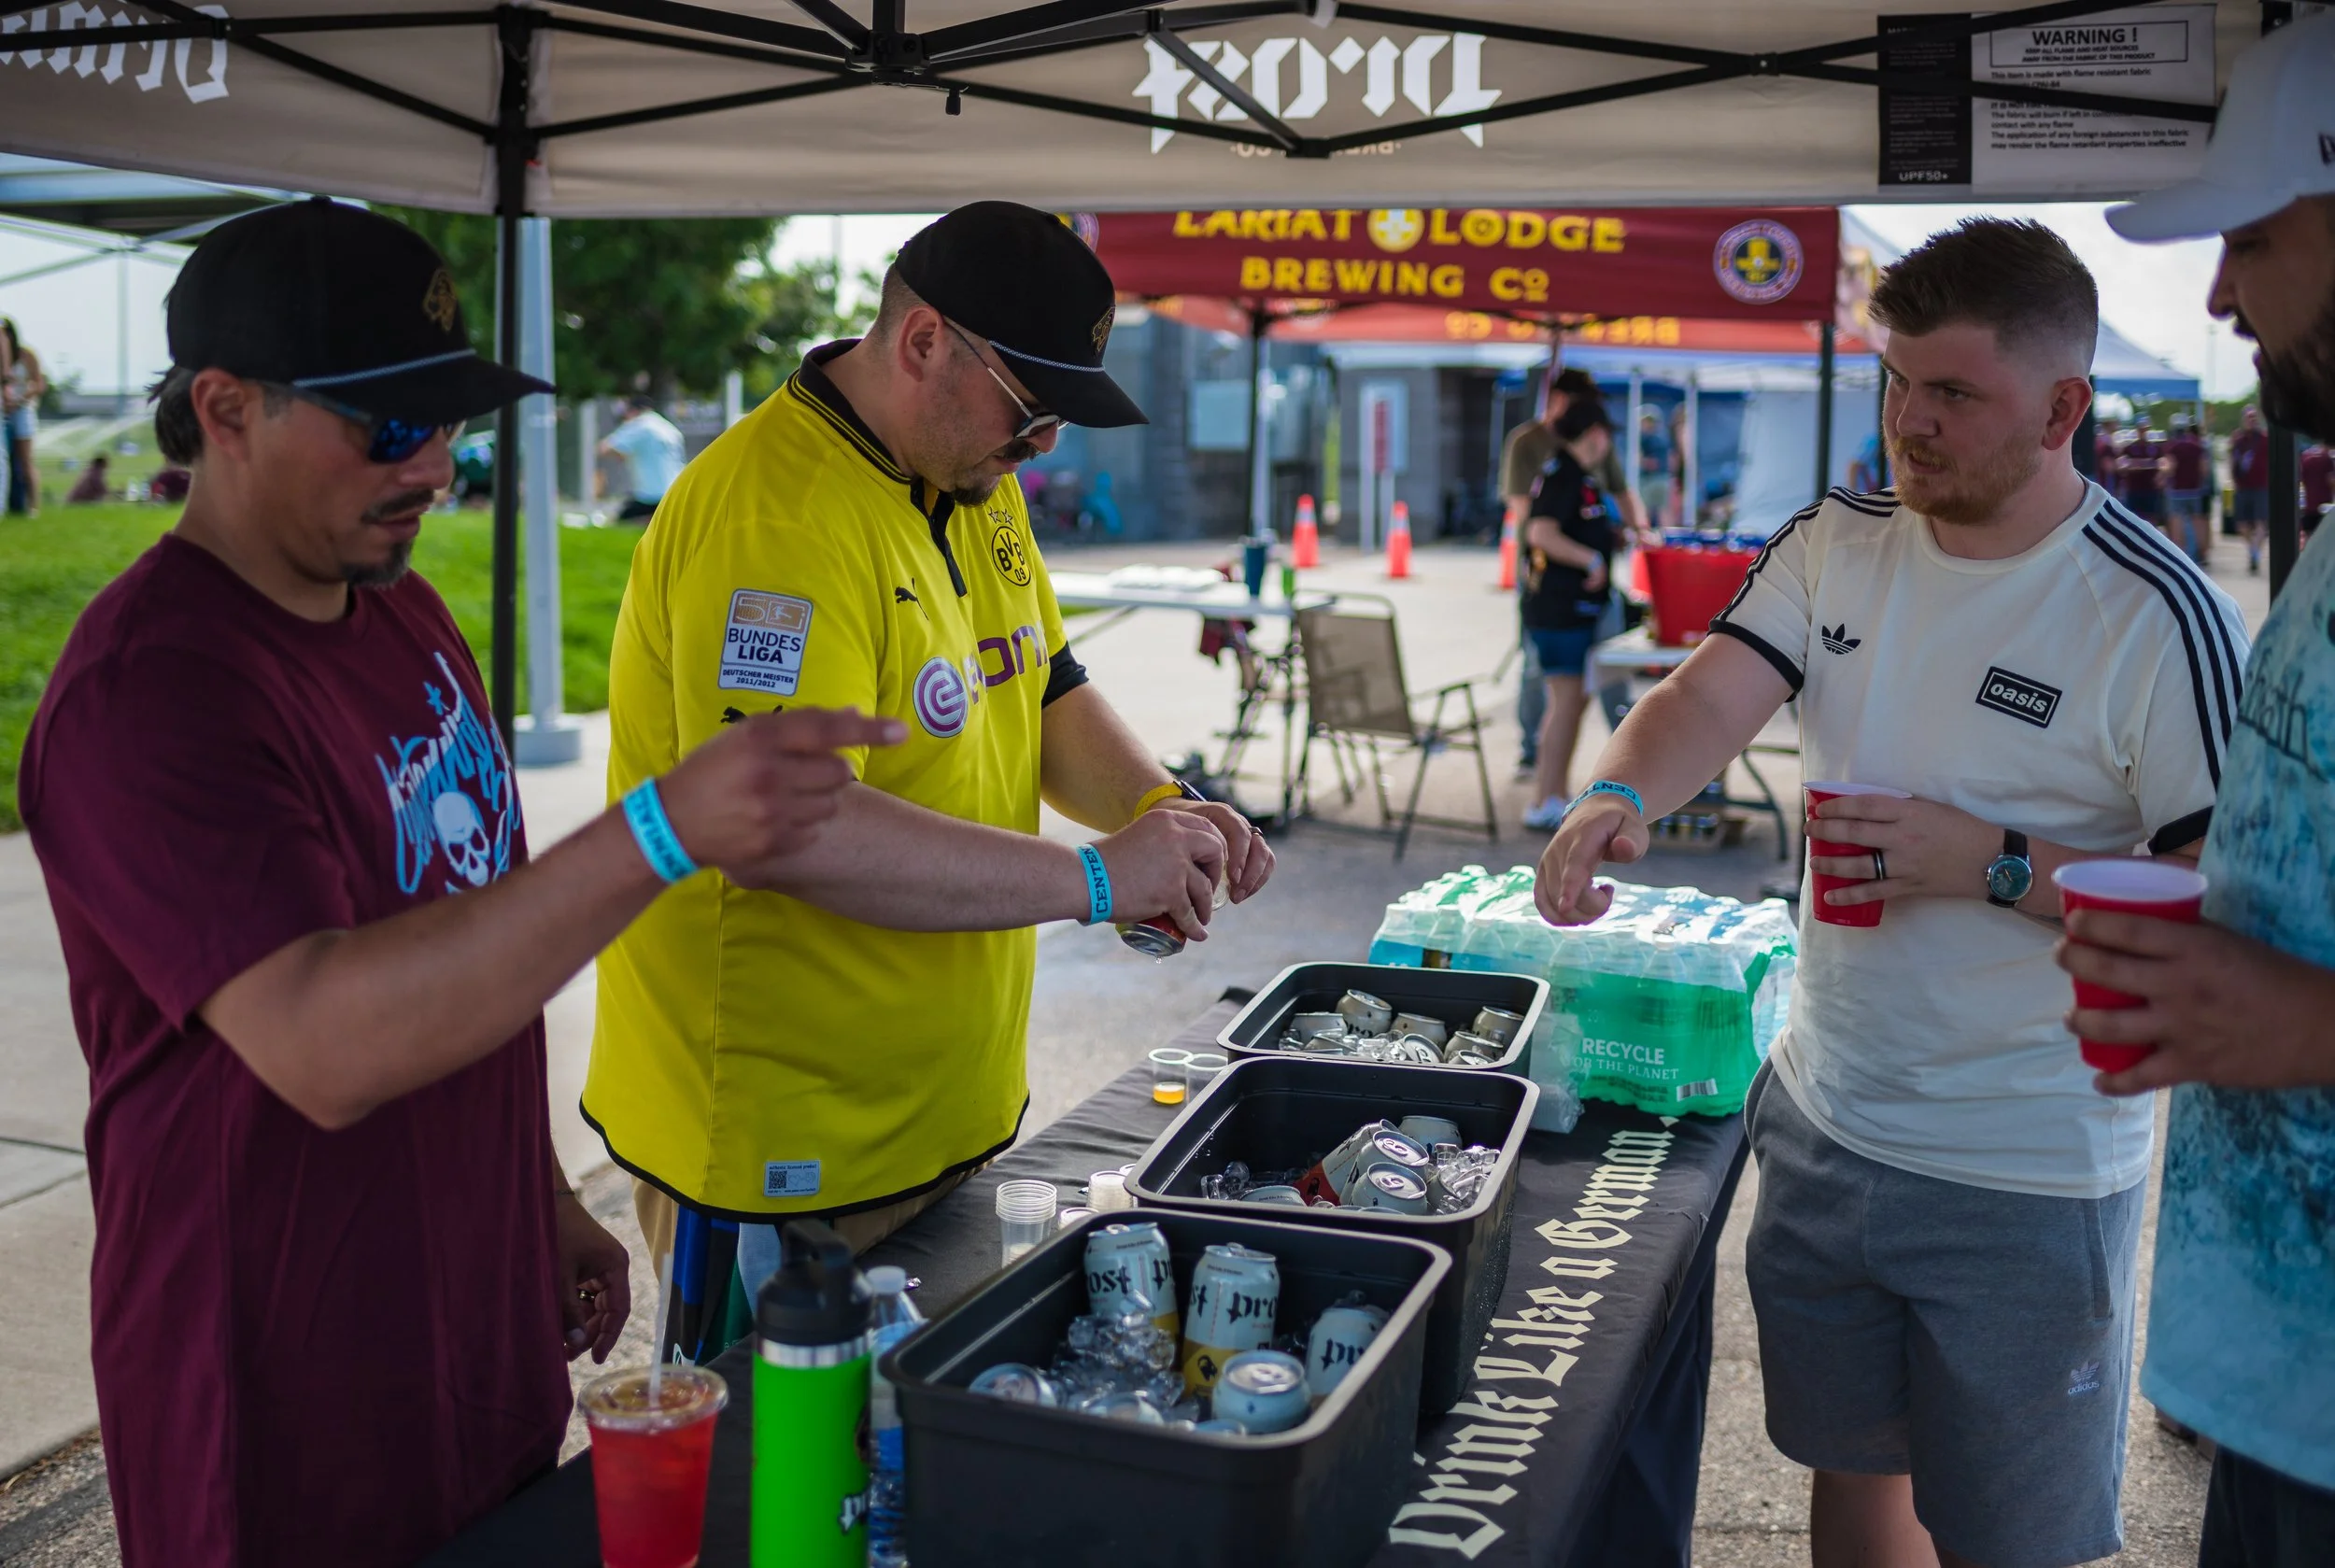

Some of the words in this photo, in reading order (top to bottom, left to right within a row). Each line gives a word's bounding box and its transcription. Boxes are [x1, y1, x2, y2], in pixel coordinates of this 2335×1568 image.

[2031, 28, 2125, 46] WARNING
[1429, 208, 1625, 253] LODGE
[1240, 256, 1465, 297] BREWING
[1014, 567, 1026, 582] 09
[729, 628, 801, 652] BUNDES
[738, 644, 784, 664] LIGA
[723, 669, 761, 679] DEUTSCHER
[763, 673, 794, 684] MEISTER
[736, 677, 776, 688] 2011/2012
[1990, 684, 2047, 713] oasis
[1581, 1038, 1664, 1066] RECYCLE
[1596, 1058, 1624, 1072] THE
[1628, 1065, 1678, 1081] PLANET
[1540, 1256, 1619, 1279] a
[1473, 1285, 1605, 1387] Like
[2068, 1382, 2100, 1395] adidas
[1388, 1391, 1559, 1561] Drink
